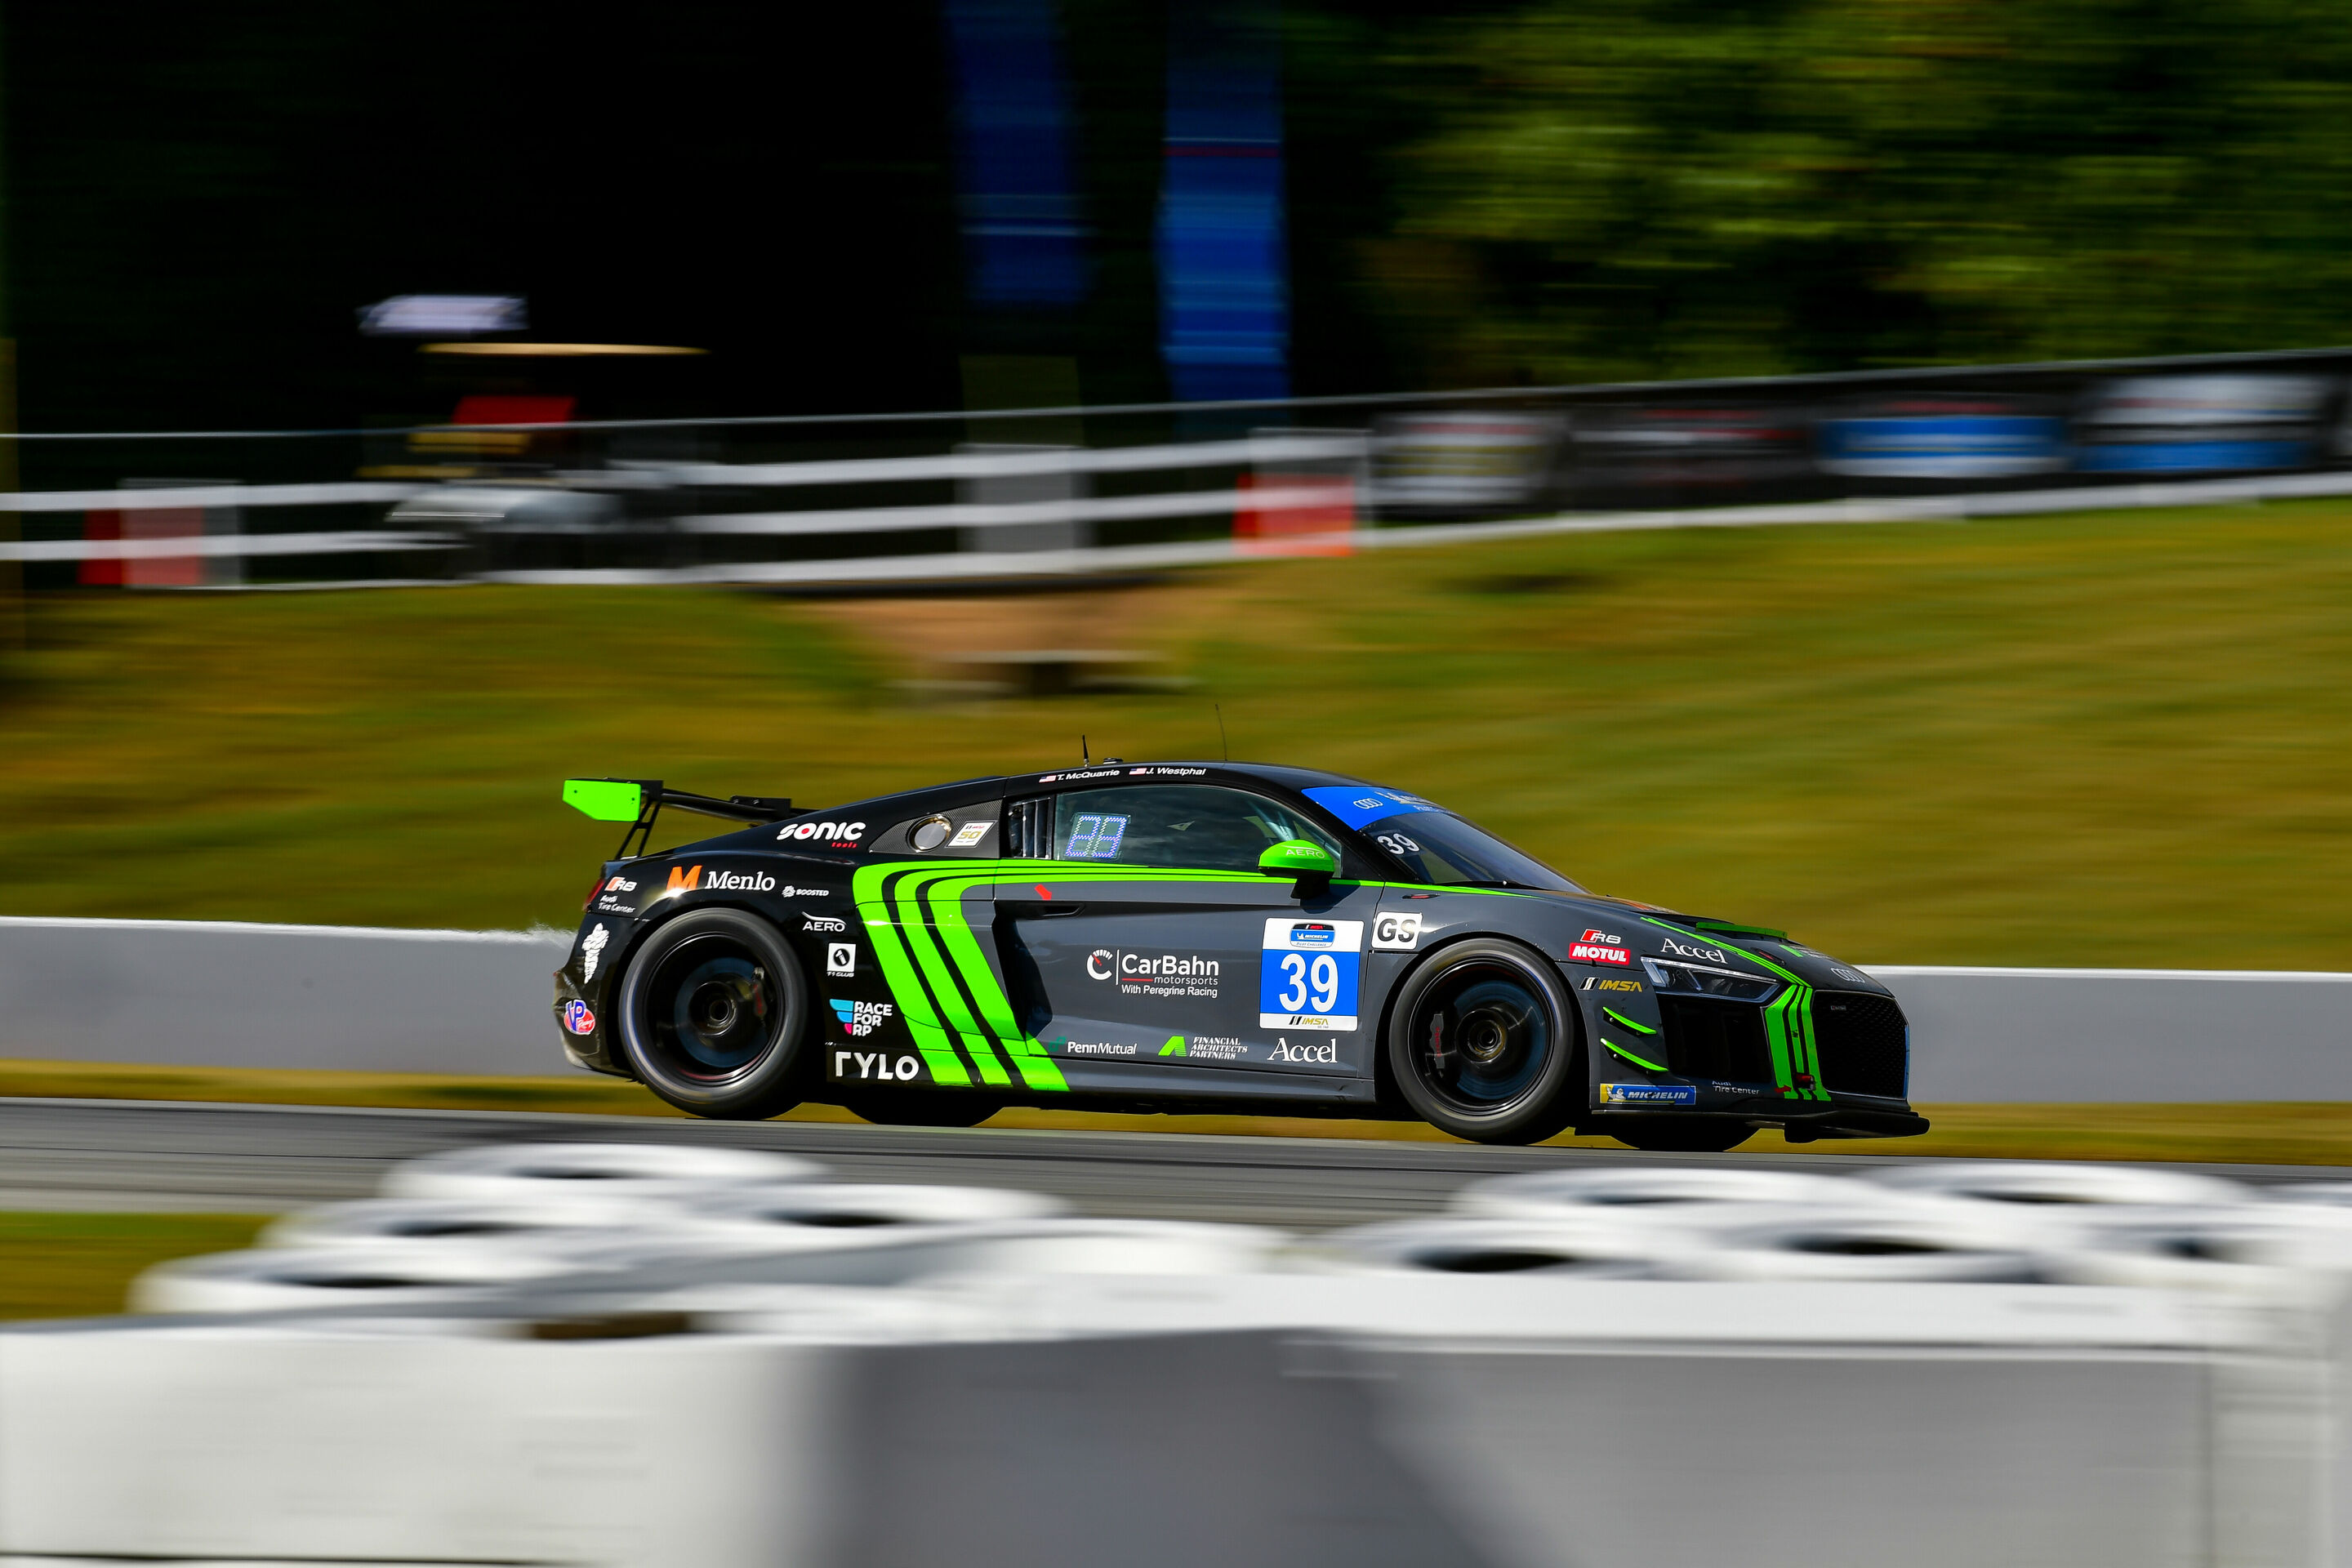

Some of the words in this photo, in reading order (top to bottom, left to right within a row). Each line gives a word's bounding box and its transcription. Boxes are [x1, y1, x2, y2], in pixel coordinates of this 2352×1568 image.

[1066, 769, 1120, 780] McQuarrie
[1157, 767, 1206, 777] Westphal
[1377, 833, 1420, 855] 39
[1285, 849, 1325, 859] AERO
[704, 871, 776, 892] Menlo
[802, 921, 845, 932] AERO
[1377, 918, 1417, 942] GS
[1586, 930, 1622, 944] R8
[1572, 946, 1627, 962] MOTUL
[1660, 938, 1728, 964] Accel
[1121, 954, 1219, 976] CarBahn
[1153, 976, 1218, 985] motorsports
[1279, 953, 1339, 1013] 39
[1598, 980, 1642, 992] IMSA
[1121, 984, 1141, 994] With
[1143, 985, 1185, 996] Peregrine
[1187, 987, 1218, 998] Racing
[853, 1000, 893, 1016] RACE
[853, 1013, 882, 1027] FOR
[852, 1023, 872, 1036] RP
[1067, 1041, 1138, 1055] PennMutual
[1193, 1036, 1241, 1046] FINANCIAL
[1189, 1050, 1237, 1060] PARTNERS
[1191, 1044, 1249, 1053] ARCHITECTS
[1267, 1037, 1338, 1063] Accel
